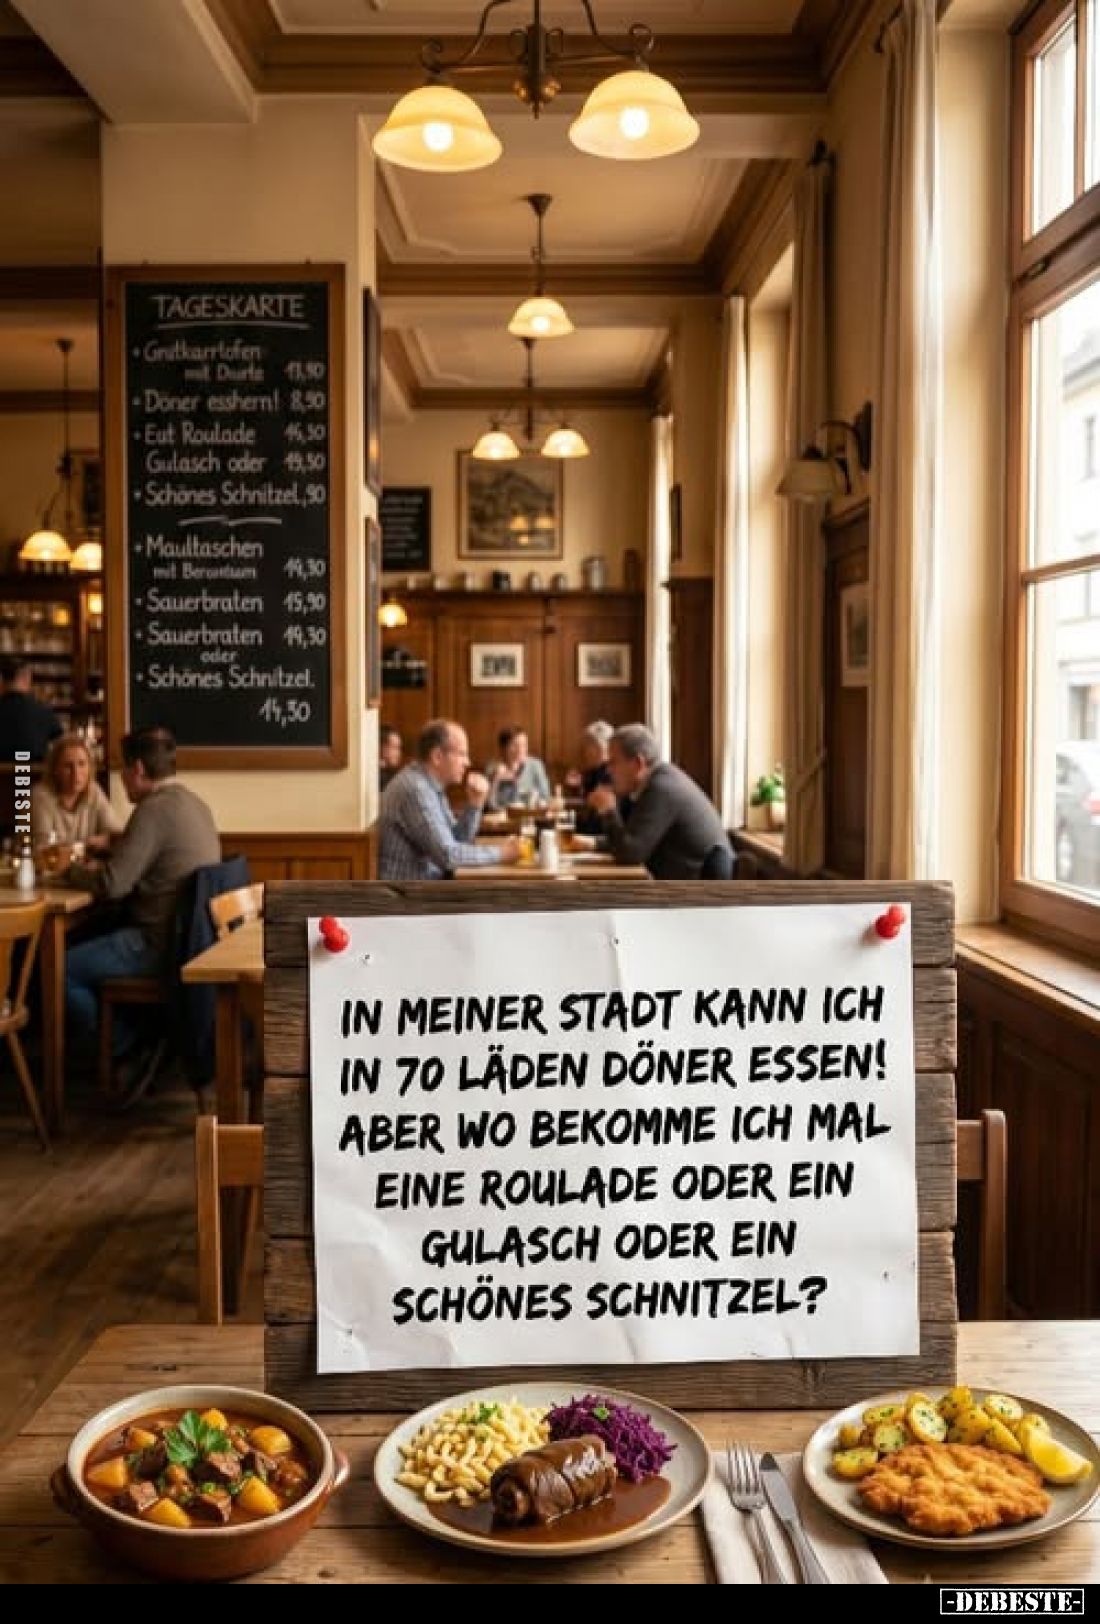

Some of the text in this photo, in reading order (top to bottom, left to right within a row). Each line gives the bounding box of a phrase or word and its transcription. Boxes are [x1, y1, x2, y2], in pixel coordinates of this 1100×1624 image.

[151, 294, 305, 319] TAGESKARTE
[182, 420, 256, 445] Roulade
[146, 449, 220, 474] Gulasch
[228, 449, 267, 473] oder
[146, 534, 264, 558] Maultaschen
[146, 587, 263, 613] Sauerbraten
[147, 620, 263, 646] Sauerbraten
[199, 647, 238, 664] oder
[148, 663, 223, 689] Schönes
[341, 986, 884, 1037] IN MEINER STADT KANN ICH
[341, 1039, 886, 1096] IN 70 LÄDEN DÖNER ESSEN!
[339, 1102, 891, 1155] ABER WO BEKOMME ICH MAL
[376, 1162, 854, 1210] EINE ROULADE ODER EIN
[422, 1221, 797, 1267] GULASCH ODER EIN
[394, 1276, 827, 1324] SCHÖNES SCHNITZEL?
